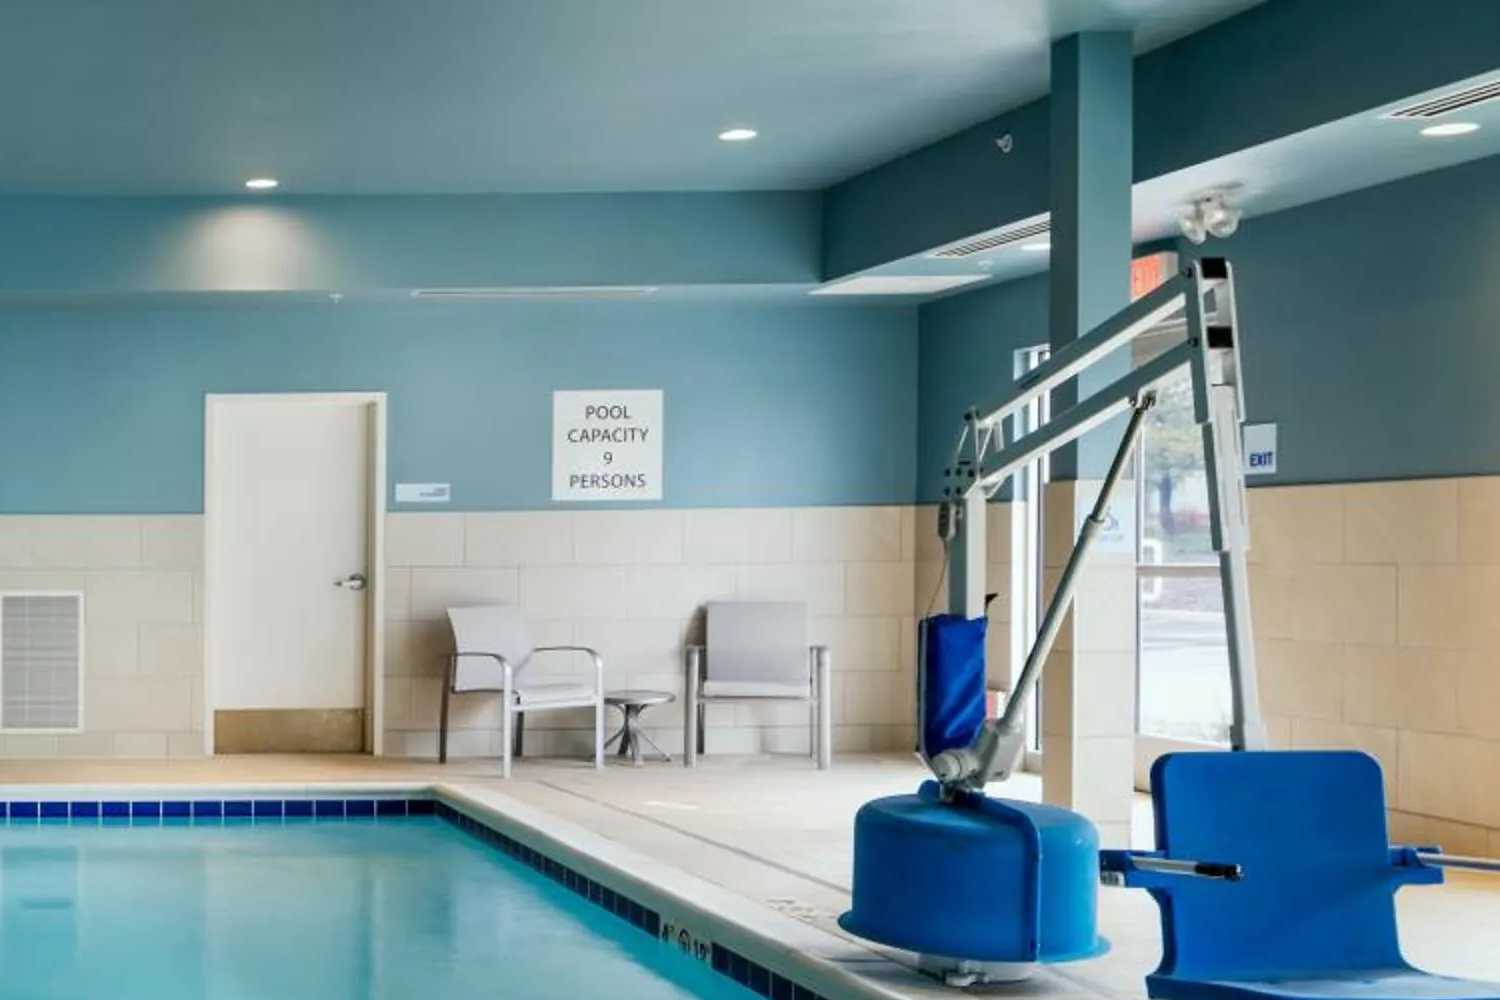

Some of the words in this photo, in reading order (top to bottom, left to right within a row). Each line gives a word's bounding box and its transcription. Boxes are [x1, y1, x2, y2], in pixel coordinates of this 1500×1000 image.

[585, 404, 632, 420] POOL
[567, 427, 649, 443] CAPACITY
[603, 451, 613, 465] 9
[1249, 452, 1273, 467] EXIT
[569, 473, 647, 489] PERSONS
